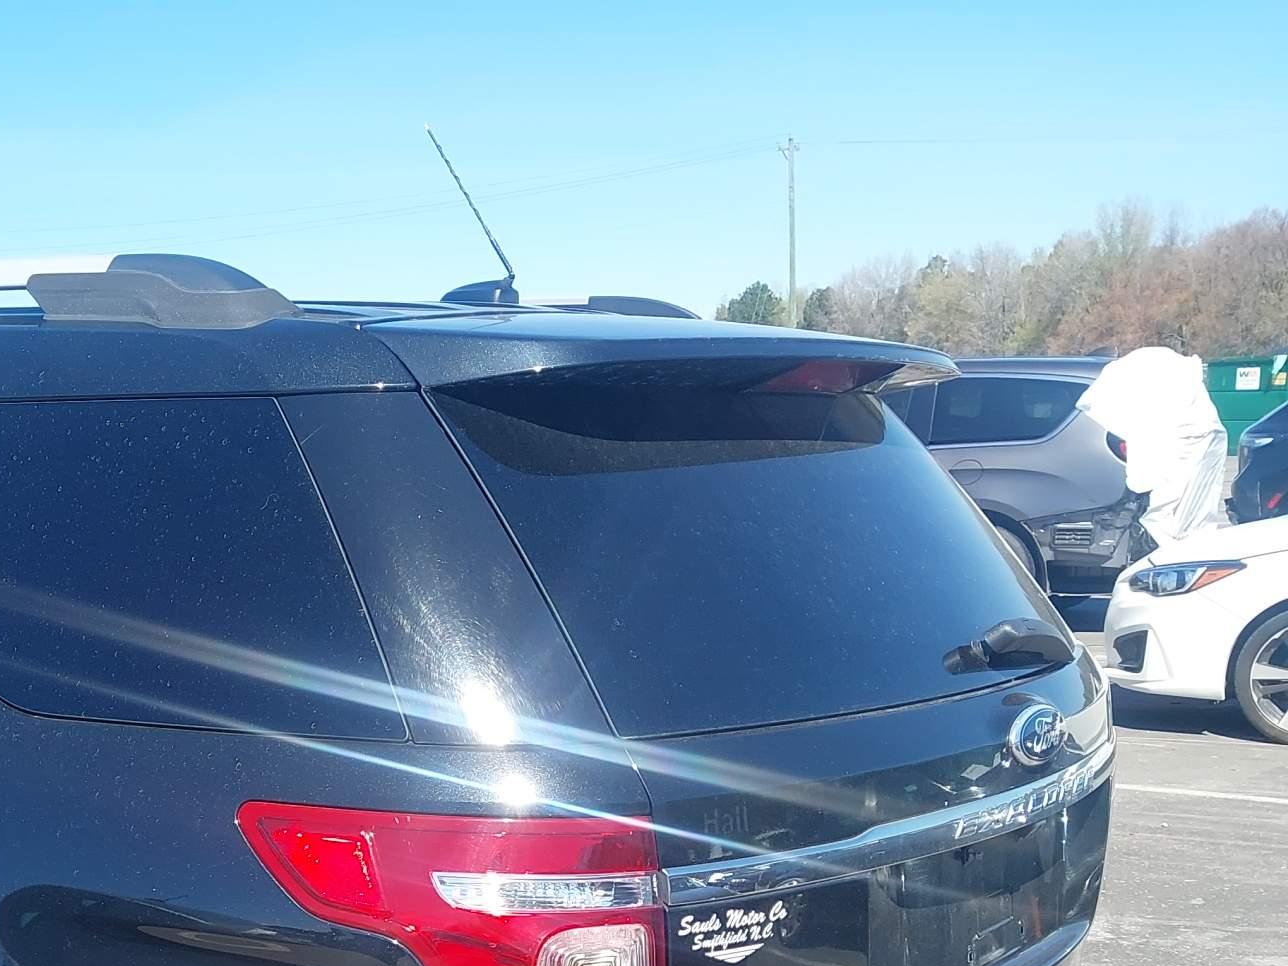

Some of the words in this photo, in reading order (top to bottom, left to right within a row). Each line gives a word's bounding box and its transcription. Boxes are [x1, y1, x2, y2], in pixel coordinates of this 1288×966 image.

[678, 913, 722, 936] Sauls
[726, 908, 767, 929] Motor
[769, 900, 788, 921] Co
[691, 926, 748, 951] Smithfield
[750, 922, 774, 941] N.C.
